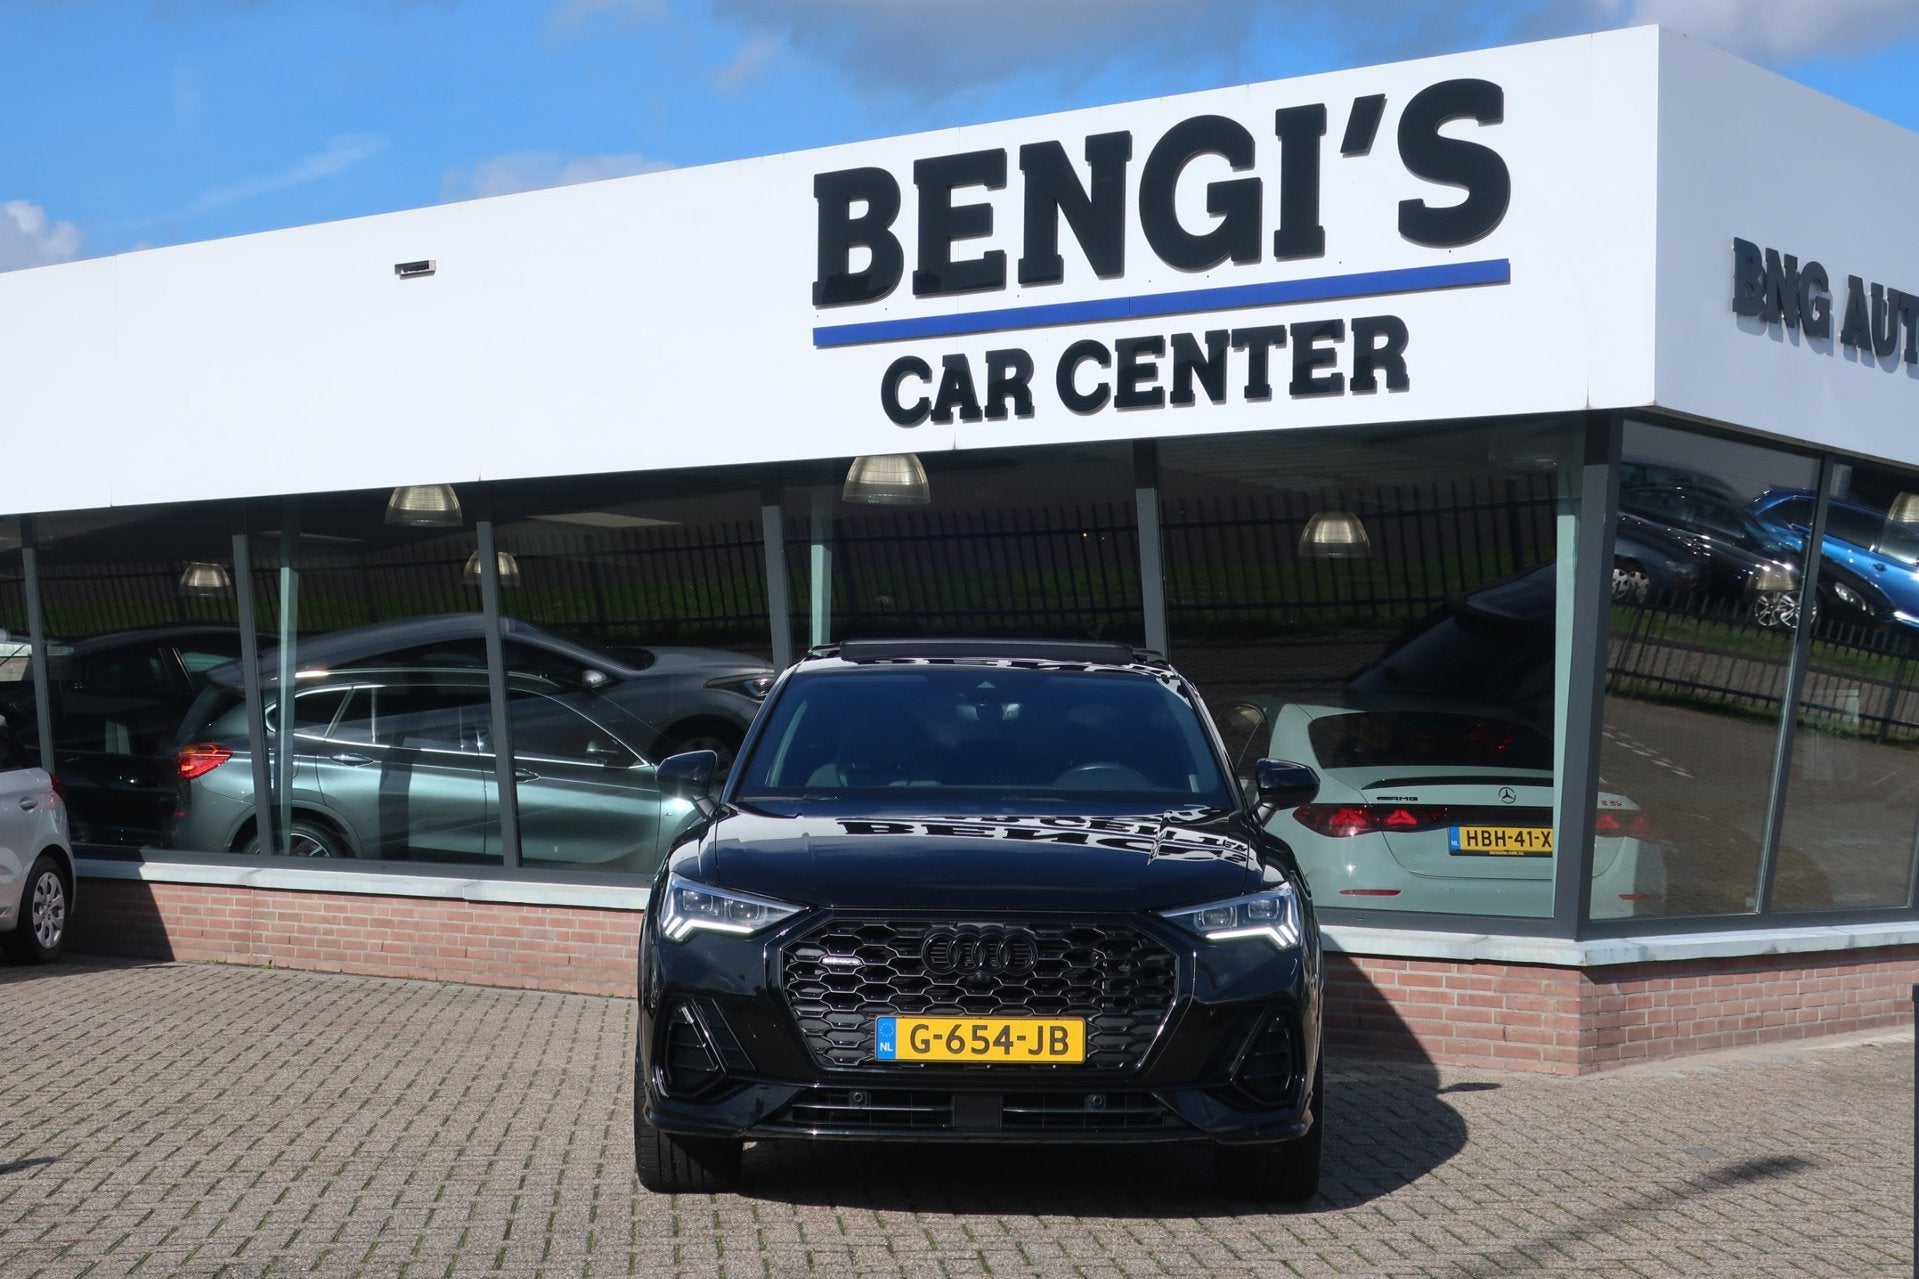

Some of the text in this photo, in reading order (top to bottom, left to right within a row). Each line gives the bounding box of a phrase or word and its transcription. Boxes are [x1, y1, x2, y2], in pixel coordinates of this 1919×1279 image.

[812, 78, 1511, 309] BENGI'S
[1732, 236, 1830, 339] BNG
[881, 315, 1410, 428] CAR CENTER
[1466, 829, 1552, 848] HBH-41-X
[879, 1041, 894, 1052] NL
[910, 1023, 1069, 1056] G-654-JB
